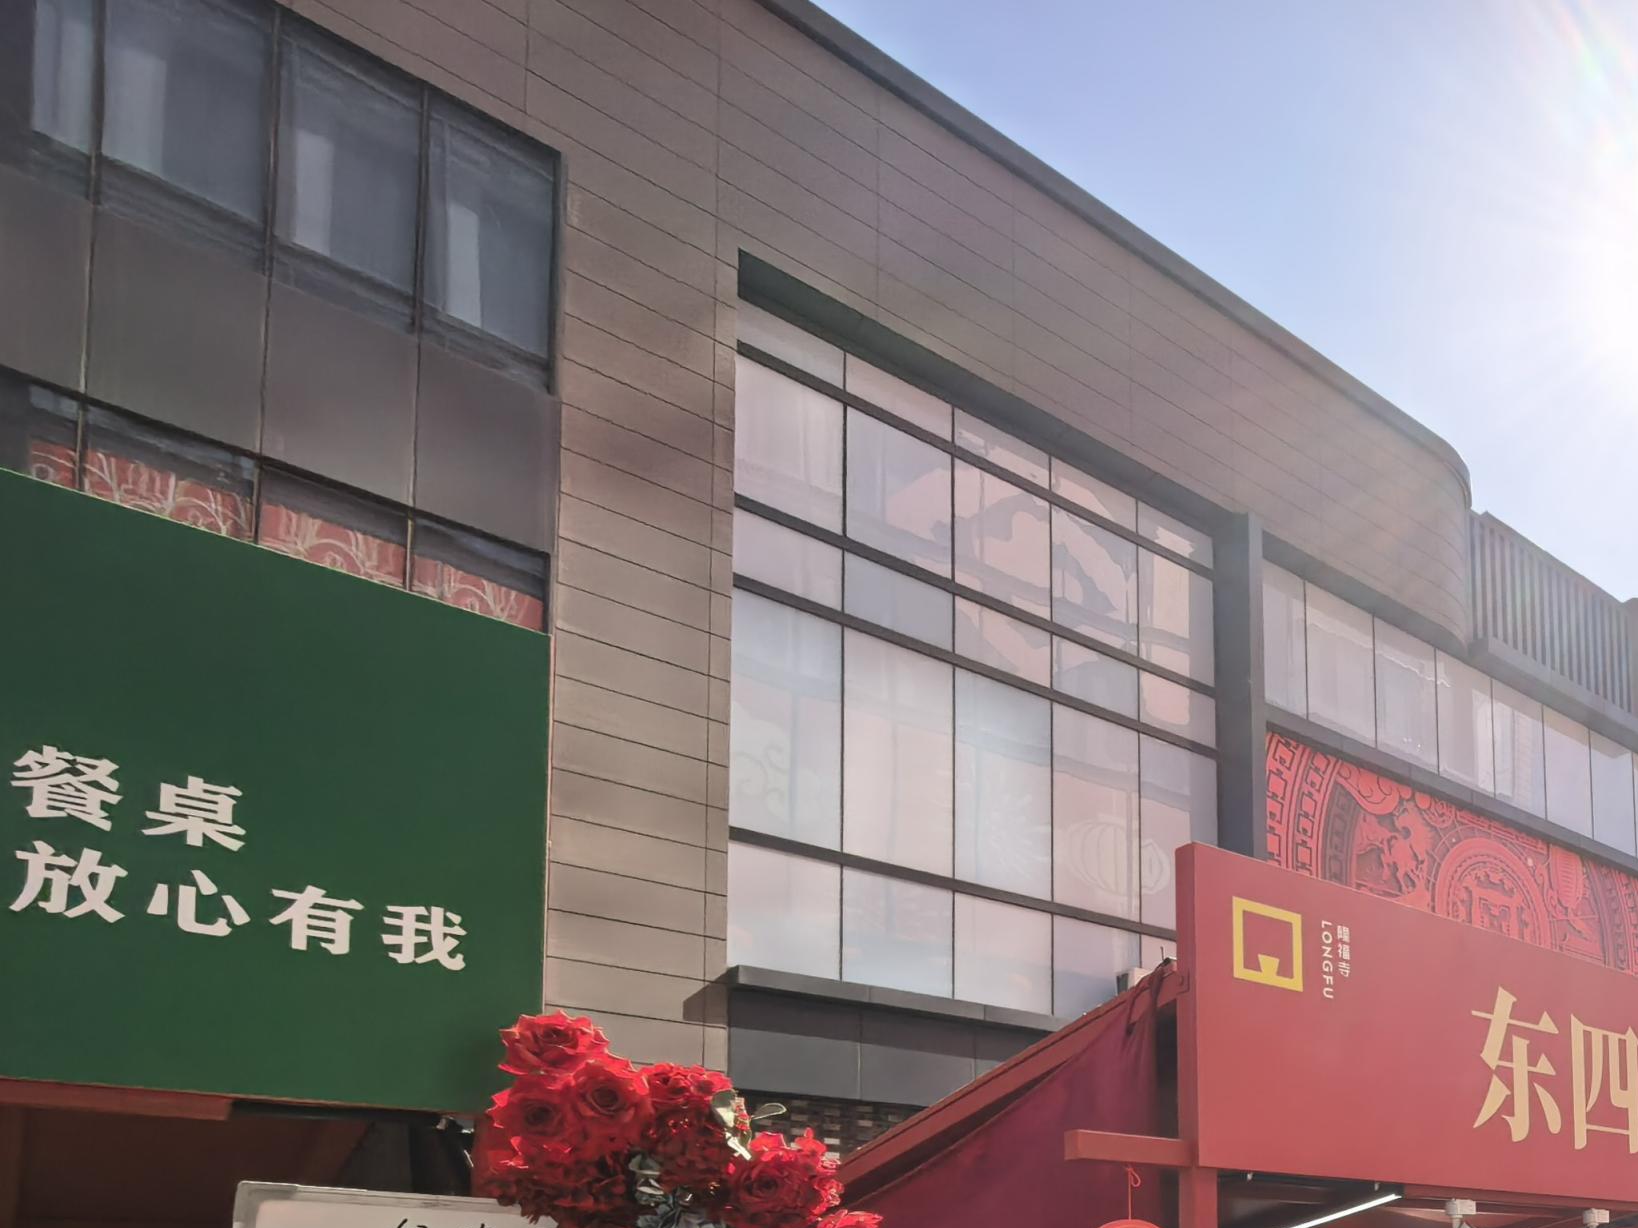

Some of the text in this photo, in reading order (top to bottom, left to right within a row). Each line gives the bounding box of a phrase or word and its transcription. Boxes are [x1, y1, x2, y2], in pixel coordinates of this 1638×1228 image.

[10, 744, 246, 851] 餐桌
[9, 840, 467, 971] 放心有我
[1321, 919, 1334, 999] LONGFU
